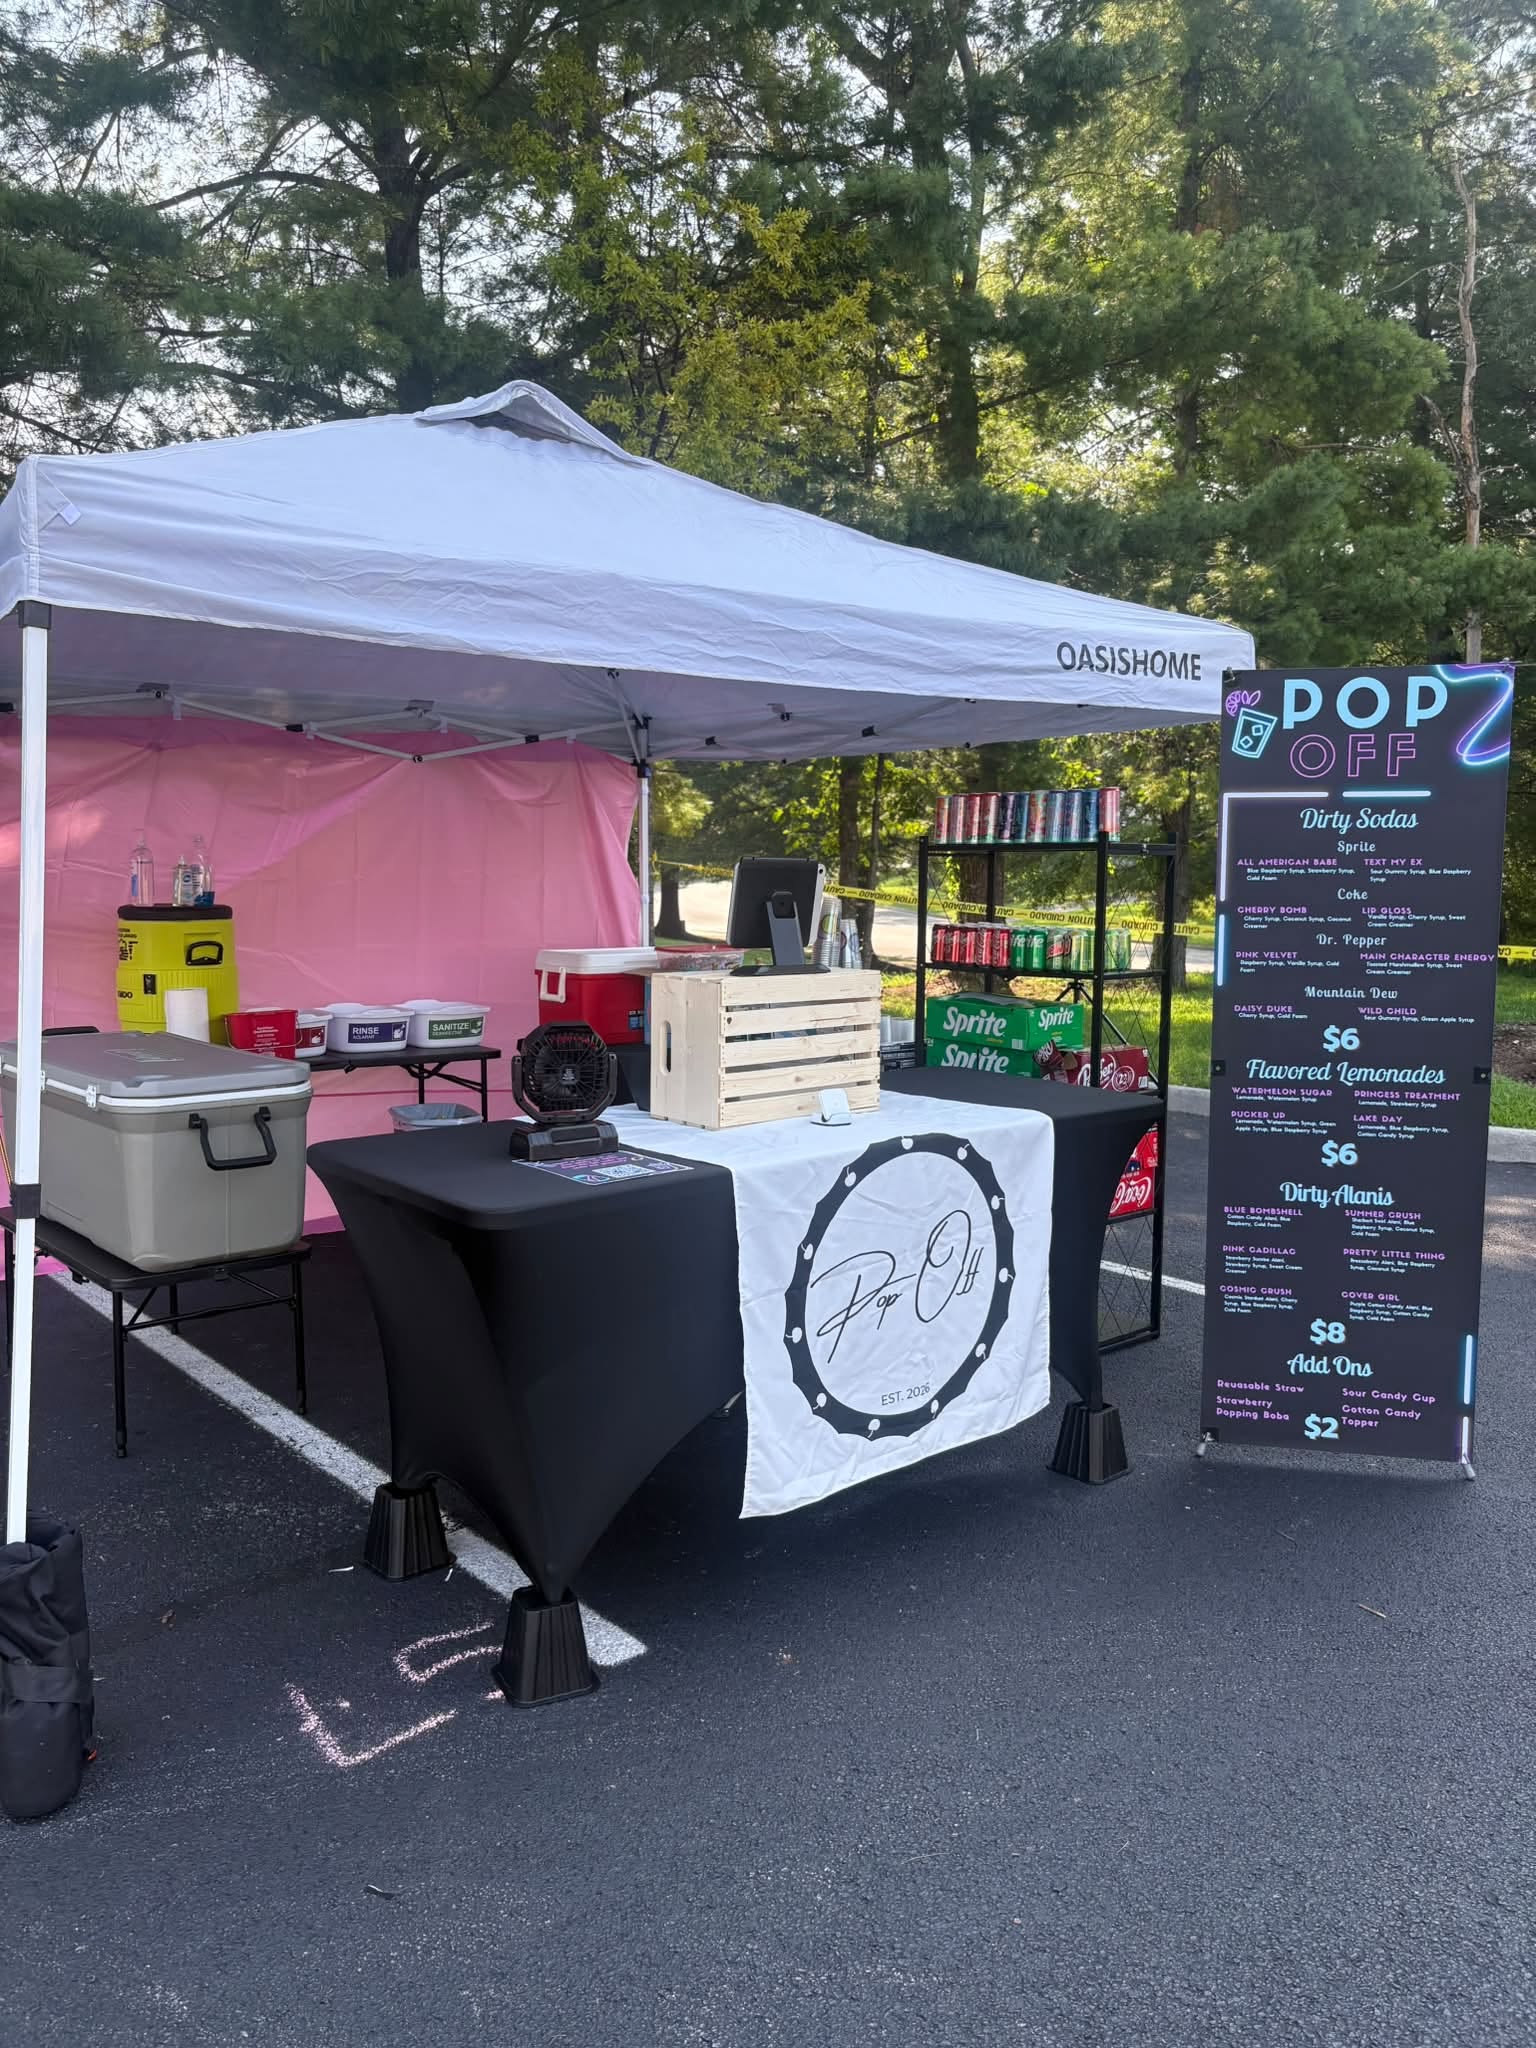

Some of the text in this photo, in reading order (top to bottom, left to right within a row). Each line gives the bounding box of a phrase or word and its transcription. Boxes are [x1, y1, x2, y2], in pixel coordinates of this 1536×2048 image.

[1056, 641, 1202, 681] OASISHOME
[1282, 676, 1448, 729] POP
[1290, 733, 1416, 778] OFF
[1300, 807, 1419, 834] Dirty Sodas
[1337, 840, 1377, 855] Sprite
[859, 890, 892, 902] CUIDADO
[894, 894, 918, 906] UTION
[1337, 888, 1368, 901] Coke
[942, 901, 977, 914] CUIDADO
[1362, 907, 1412, 915] LIP GLOSS
[1029, 911, 1066, 922] CUIDADO
[1069, 914, 1096, 926] UTION
[1121, 921, 1158, 932] CUIDADO
[1316, 933, 1387, 949] Dr. Pepper
[1304, 985, 1399, 1000] Mountain Dew
[943, 1006, 1007, 1037] Sprite
[1038, 1006, 1074, 1031] Sprite
[352, 1027, 380, 1035] RINSE
[432, 1022, 470, 1031] SANITIZE
[1322, 1024, 1360, 1052] $6
[941, 1043, 1010, 1074] Sprite
[1246, 1059, 1447, 1086] Flavored Lemonades
[1354, 1091, 1460, 1100] PRINCESS TREATMENT
[1321, 1139, 1358, 1167] $6
[1280, 1181, 1395, 1208] Dirty Alanis
[1250, 1208, 1303, 1216] BOMBSHELL
[1345, 1210, 1421, 1220] SUMMER CRUSH
[1249, 1247, 1296, 1255] CADILLAC
[1416, 1252, 1445, 1260] THING
[810, 1209, 985, 1364] Pop Off
[1342, 1292, 1374, 1300] COVER
[1310, 1318, 1346, 1345] $8
[1287, 1353, 1373, 1377] Add Ons
[881, 1383, 931, 1406] EST. 2026
[1275, 1383, 1304, 1392] Straw
[1216, 1395, 1272, 1409] Strawberry
[1342, 1387, 1436, 1404] Sour Candy Cup
[1216, 1407, 1290, 1421] Popping Boba
[1341, 1404, 1421, 1420] Cotton Candy
[1304, 1413, 1339, 1439] $2
[1341, 1416, 1379, 1428] Topper
